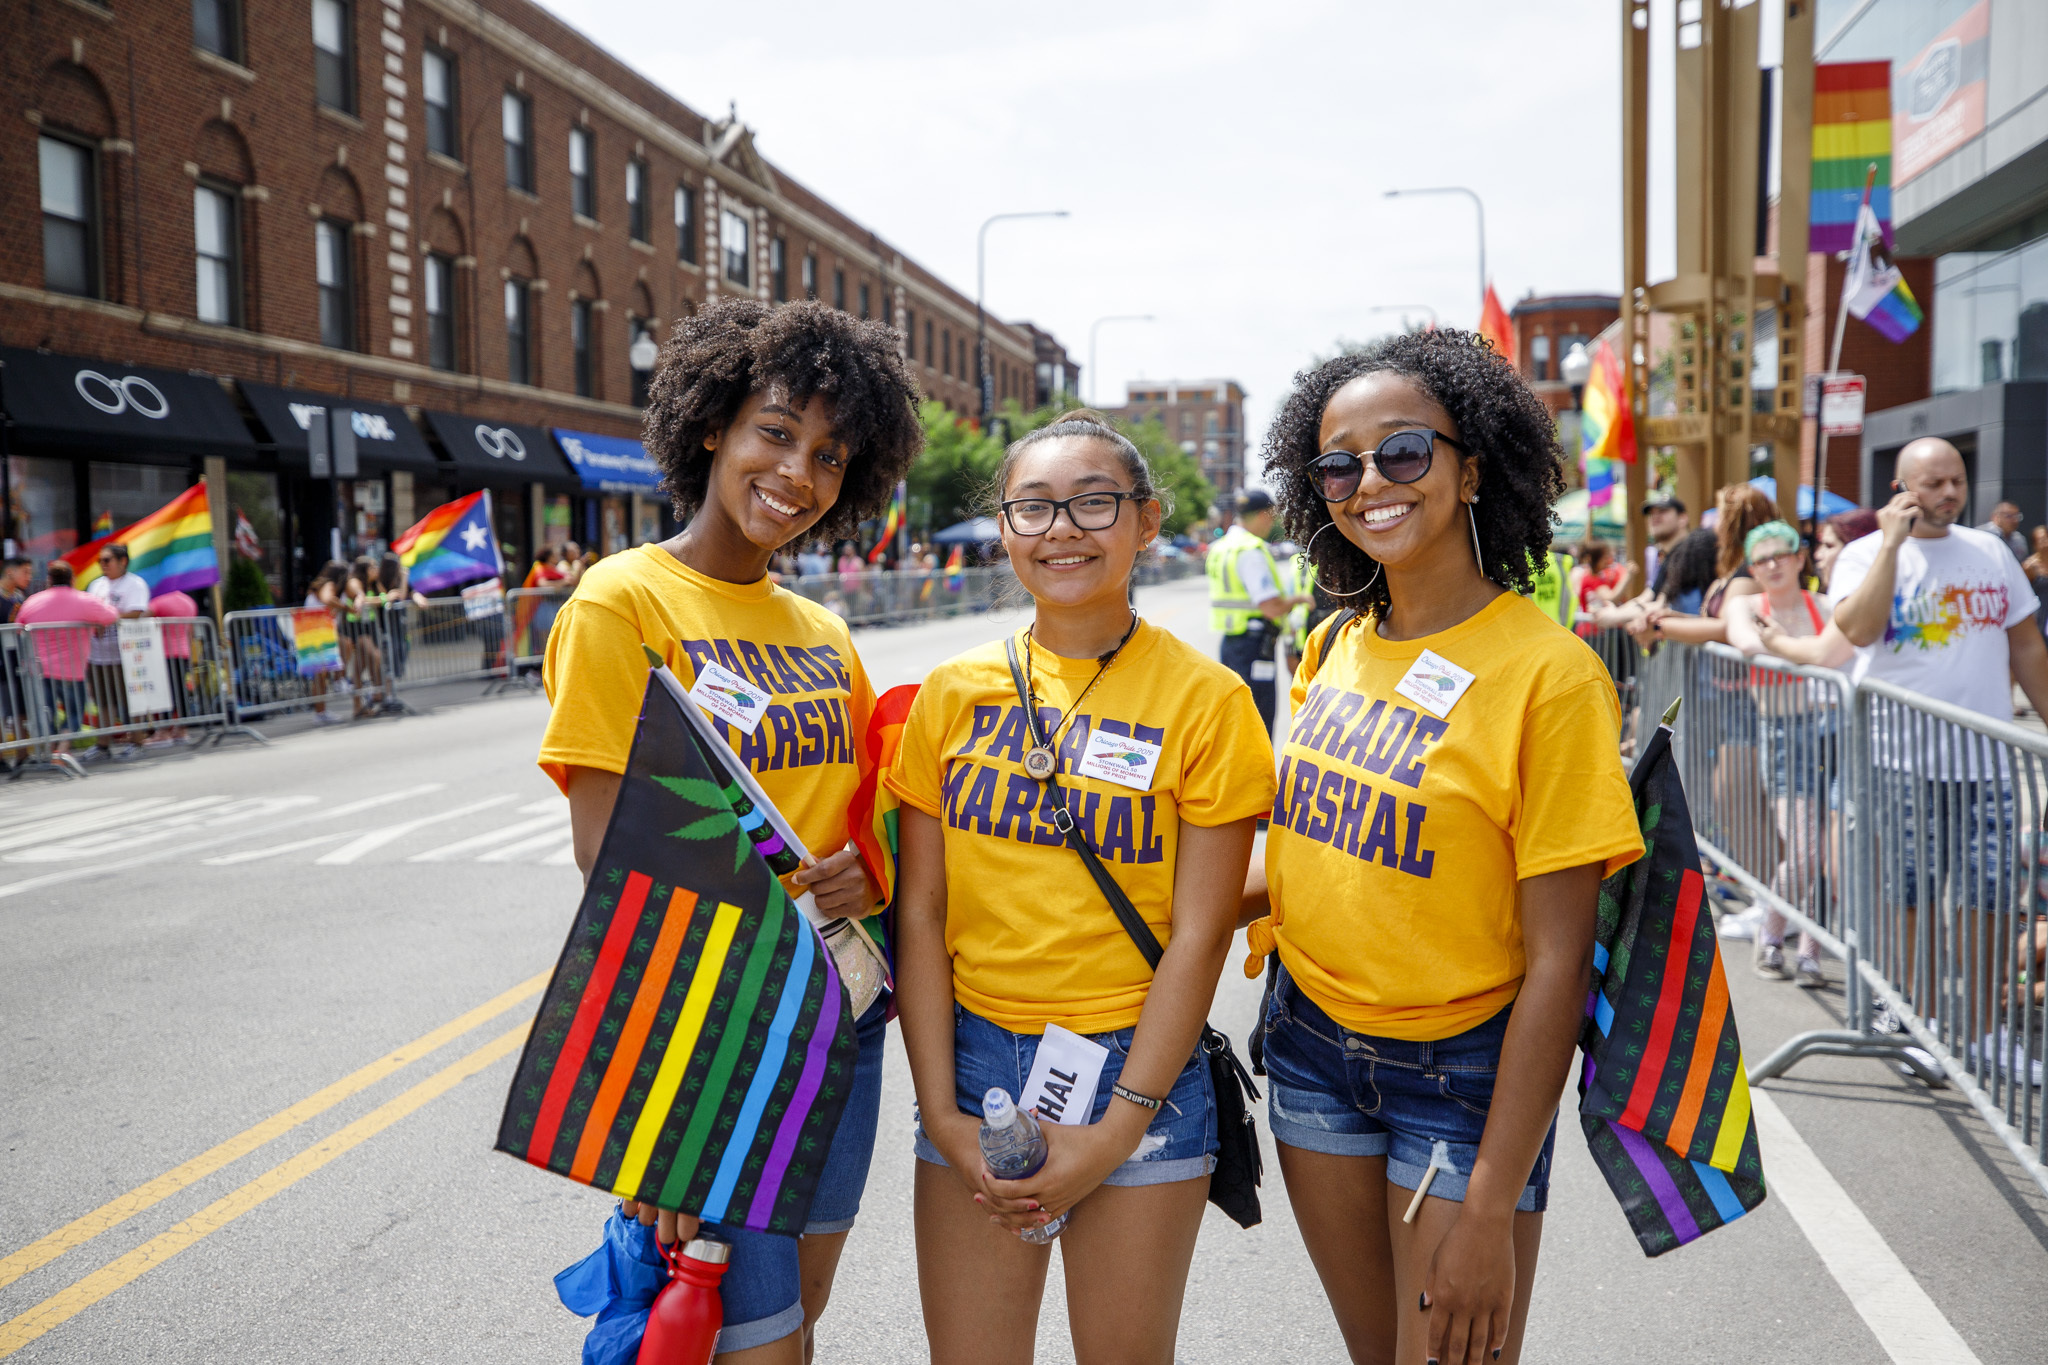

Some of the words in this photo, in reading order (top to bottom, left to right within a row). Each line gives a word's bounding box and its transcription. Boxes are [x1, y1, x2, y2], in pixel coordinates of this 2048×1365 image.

[681, 639, 851, 694] PARADE
[709, 667, 731, 683] Chicago
[731, 680, 747, 693] Pride
[746, 690, 764, 702] 2019
[709, 690, 737, 709] STONEWALL
[696, 688, 719, 705] MILLIONS
[727, 707, 753, 724] MOMENTS
[718, 707, 733, 718] PRIDE
[1095, 735, 1118, 748] Chicago
[1118, 741, 1136, 752] Pride
[1136, 747, 1154, 757] 2019
[1290, 683, 1450, 789] PARADE
[1086, 760, 1111, 771] MILLIONS
[1119, 769, 1147, 781] MOMENTS
[1099, 759, 1129, 771] STONEWALL
[1111, 772, 1127, 780] PRIDE
[941, 758, 1164, 864] MARSHAL
[1273, 754, 1436, 879] ARSHAL
[1036, 1067, 1078, 1122] HAL
